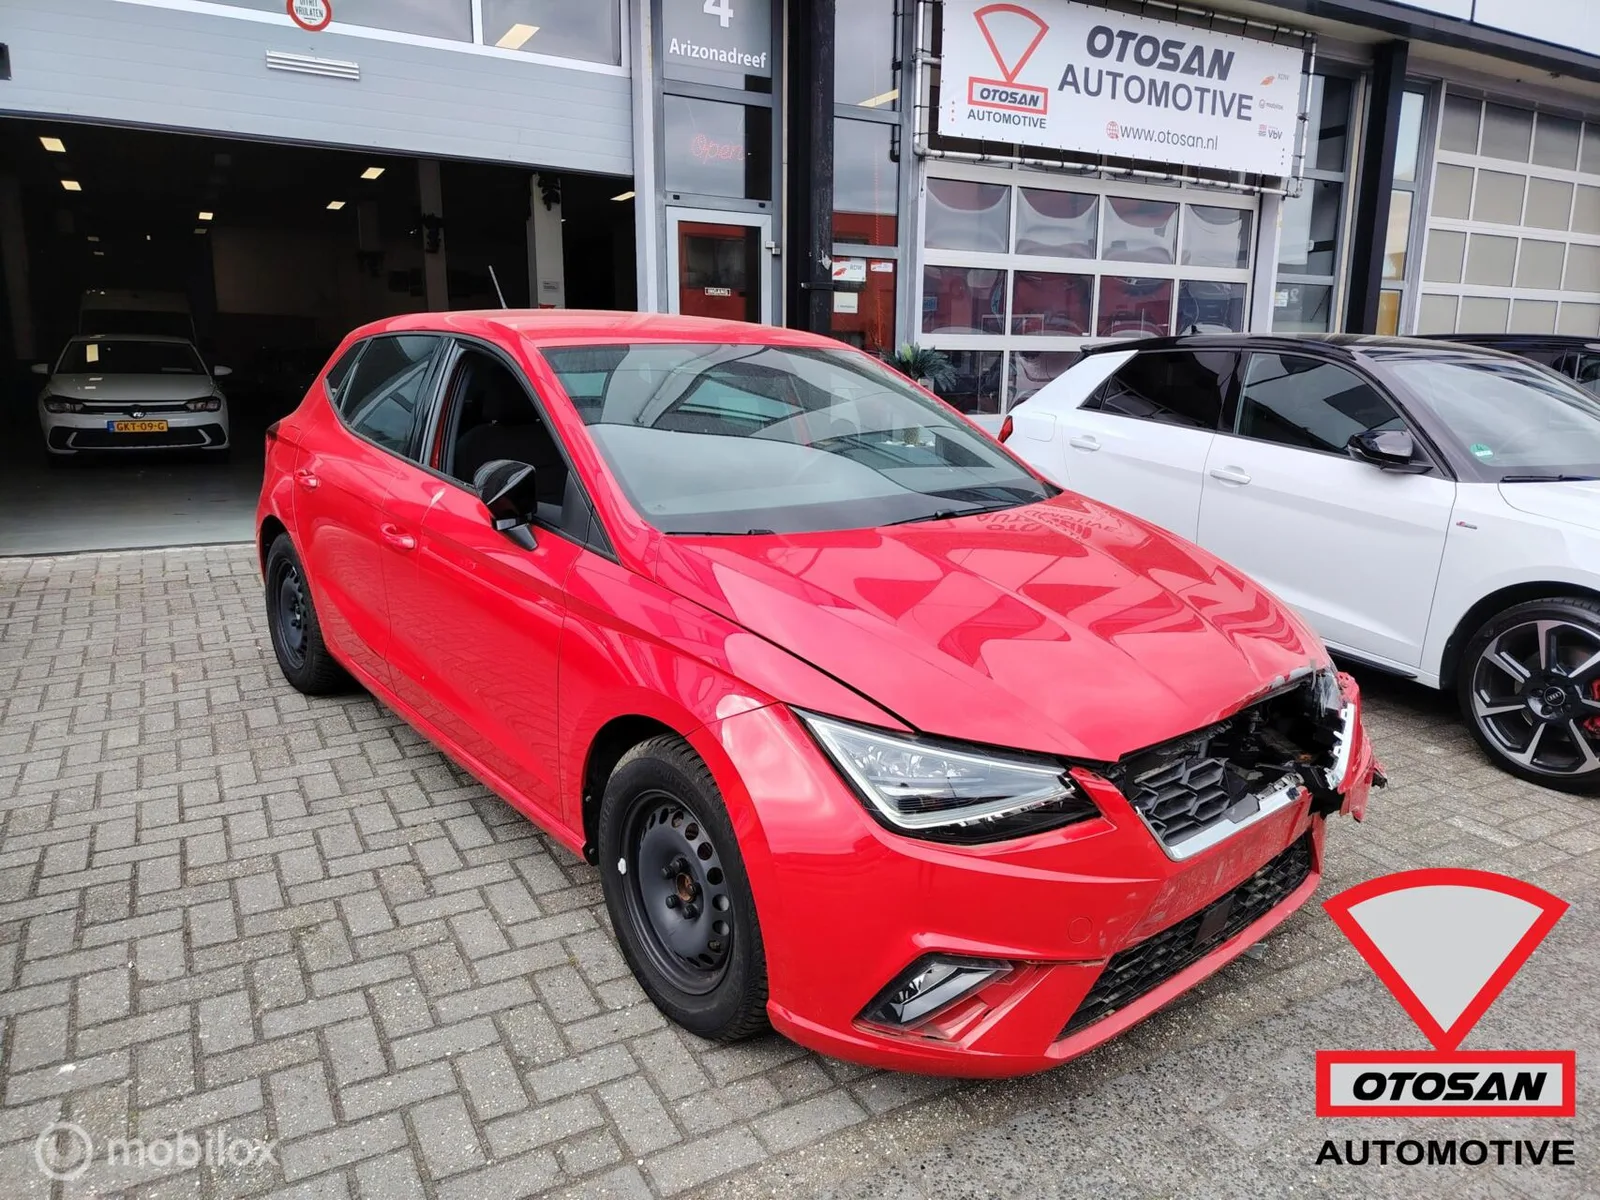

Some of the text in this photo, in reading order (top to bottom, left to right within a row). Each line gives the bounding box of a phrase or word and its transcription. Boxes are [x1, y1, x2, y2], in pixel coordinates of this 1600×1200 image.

[703, 0, 734, 28] 4
[669, 37, 767, 68] Arizonadreef
[1086, 25, 1235, 81] OTOSAN
[980, 87, 1040, 107] OTOSAN
[1058, 63, 1253, 121] AUTOMOTIVE
[967, 108, 1047, 129] AUTOMOTIVE
[1120, 124, 1218, 150] www.otosan.nl
[116, 422, 165, 431] GKT-09-G
